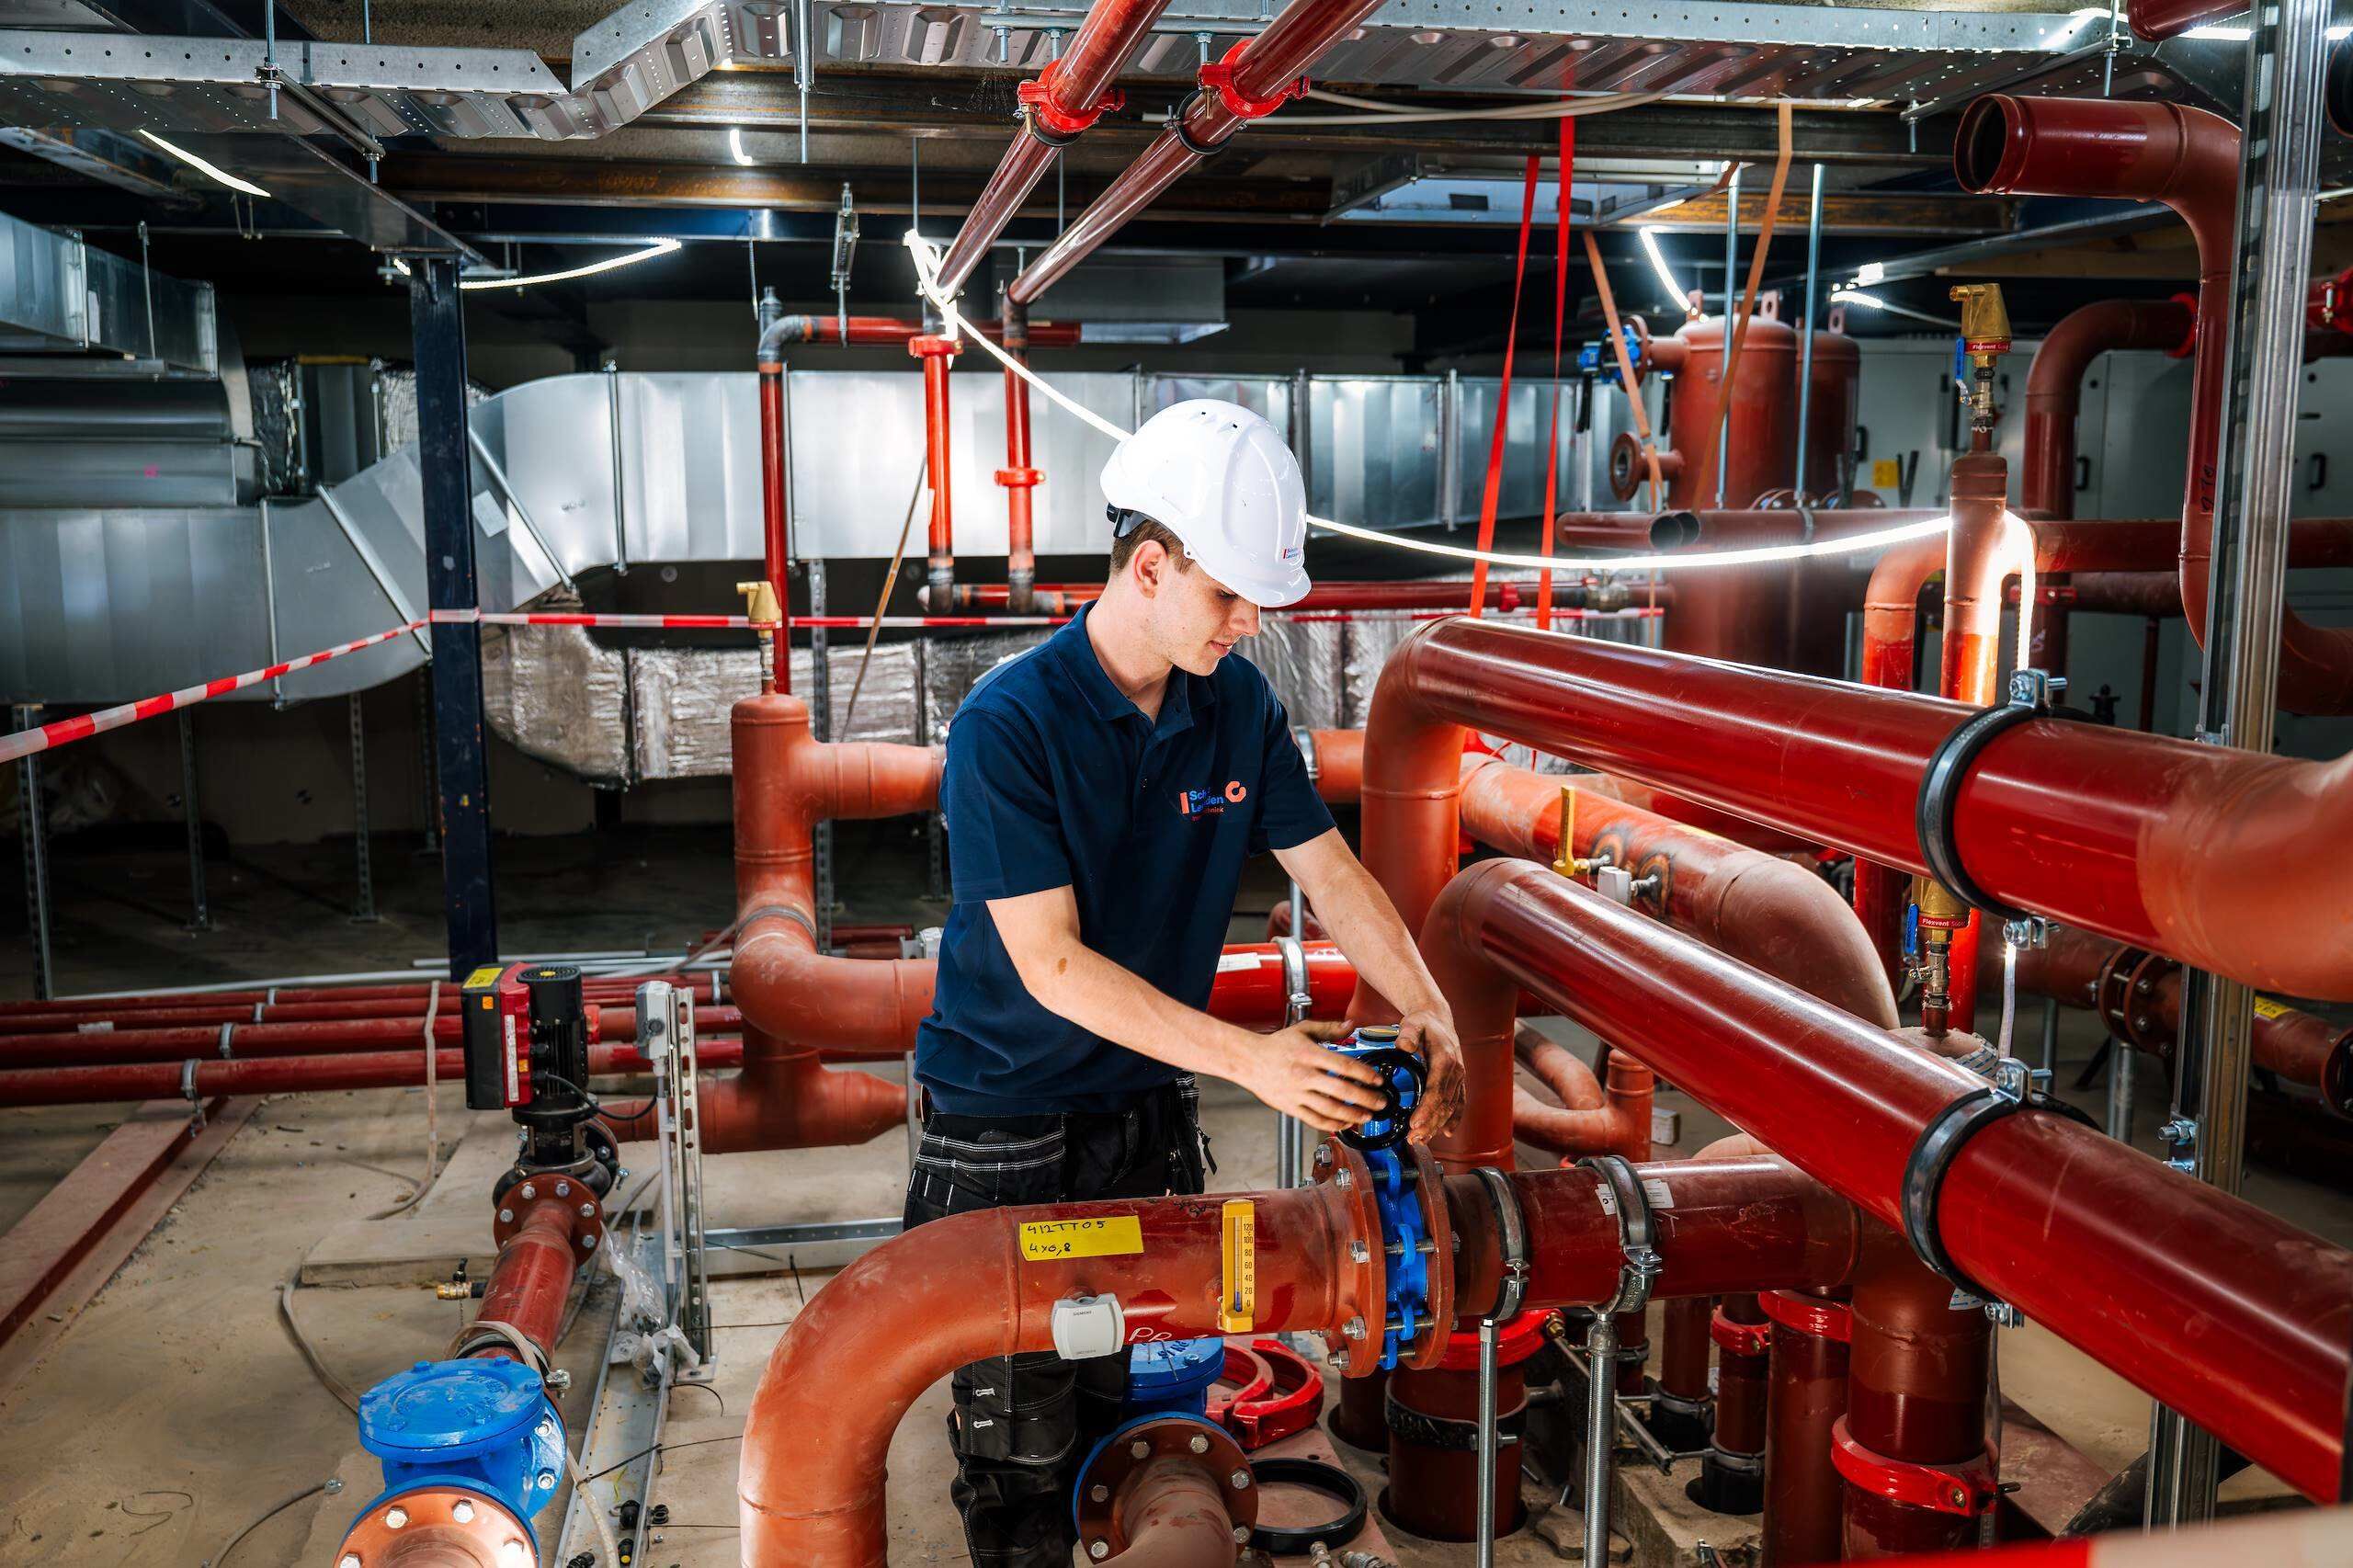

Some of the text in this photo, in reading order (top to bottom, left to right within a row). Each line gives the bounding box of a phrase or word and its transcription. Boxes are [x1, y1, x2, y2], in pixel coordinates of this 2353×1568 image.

[1922, 918, 1949, 926] Flexvent
[1243, 1222, 1253, 1232] 120
[1244, 1248, 1253, 1257] 80
[1244, 1261, 1253, 1269] 60
[1244, 1274, 1253, 1282] 40
[1245, 1287, 1253, 1295] 20
